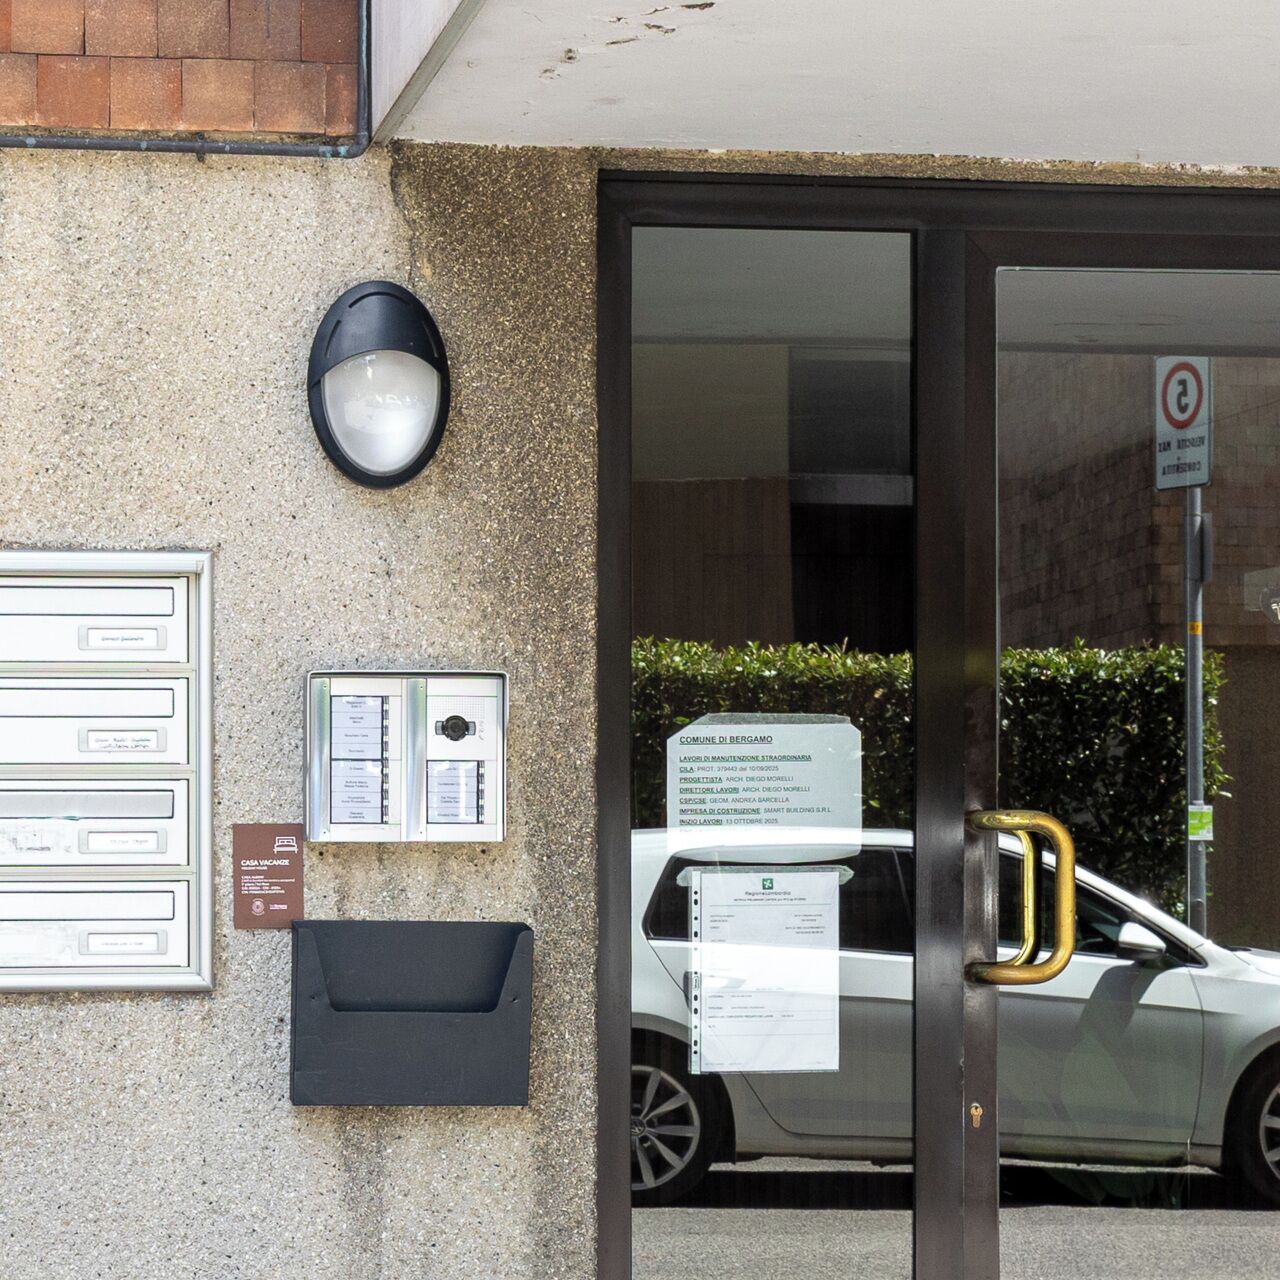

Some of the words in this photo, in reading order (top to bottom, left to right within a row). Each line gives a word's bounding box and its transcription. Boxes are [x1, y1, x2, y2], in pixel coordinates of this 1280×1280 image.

[679, 735, 717, 744] COMUNE
[719, 735, 728, 743] DI
[729, 735, 773, 743] BERGAMO
